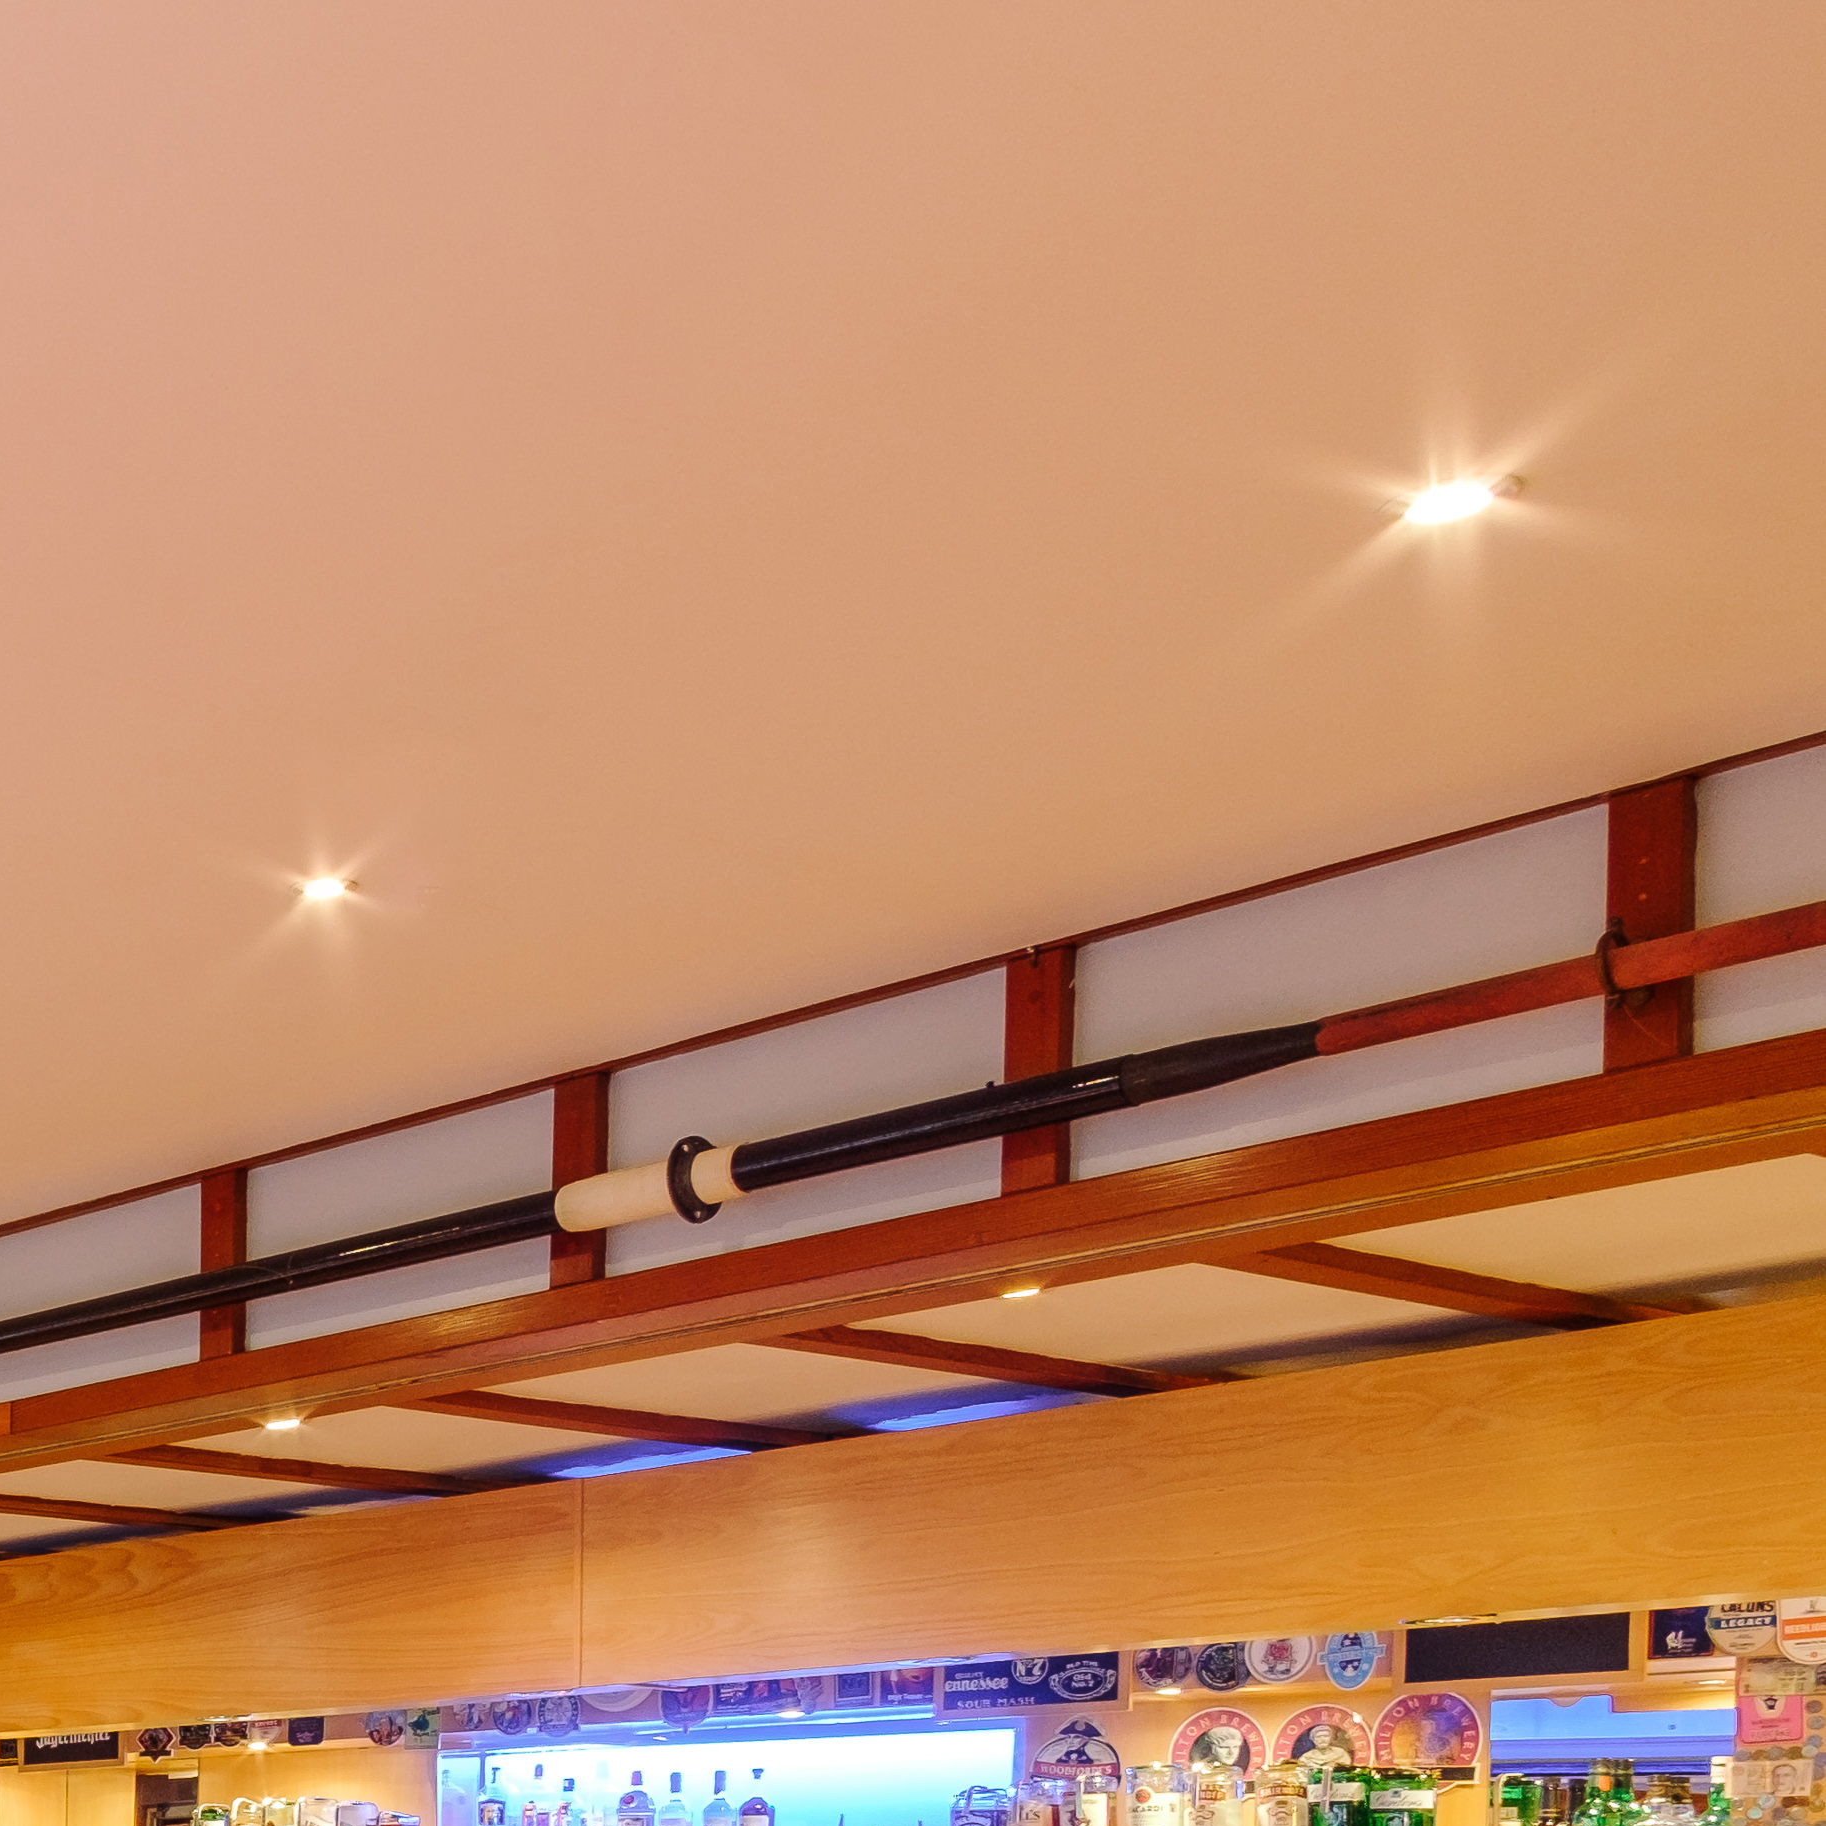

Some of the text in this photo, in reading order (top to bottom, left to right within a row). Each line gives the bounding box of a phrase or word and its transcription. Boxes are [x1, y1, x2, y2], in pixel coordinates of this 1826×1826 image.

[1720, 1616, 1773, 1628] LEGACY
[945, 1677, 1009, 1692] ennessee
[1377, 1697, 1420, 1762] MILTON
